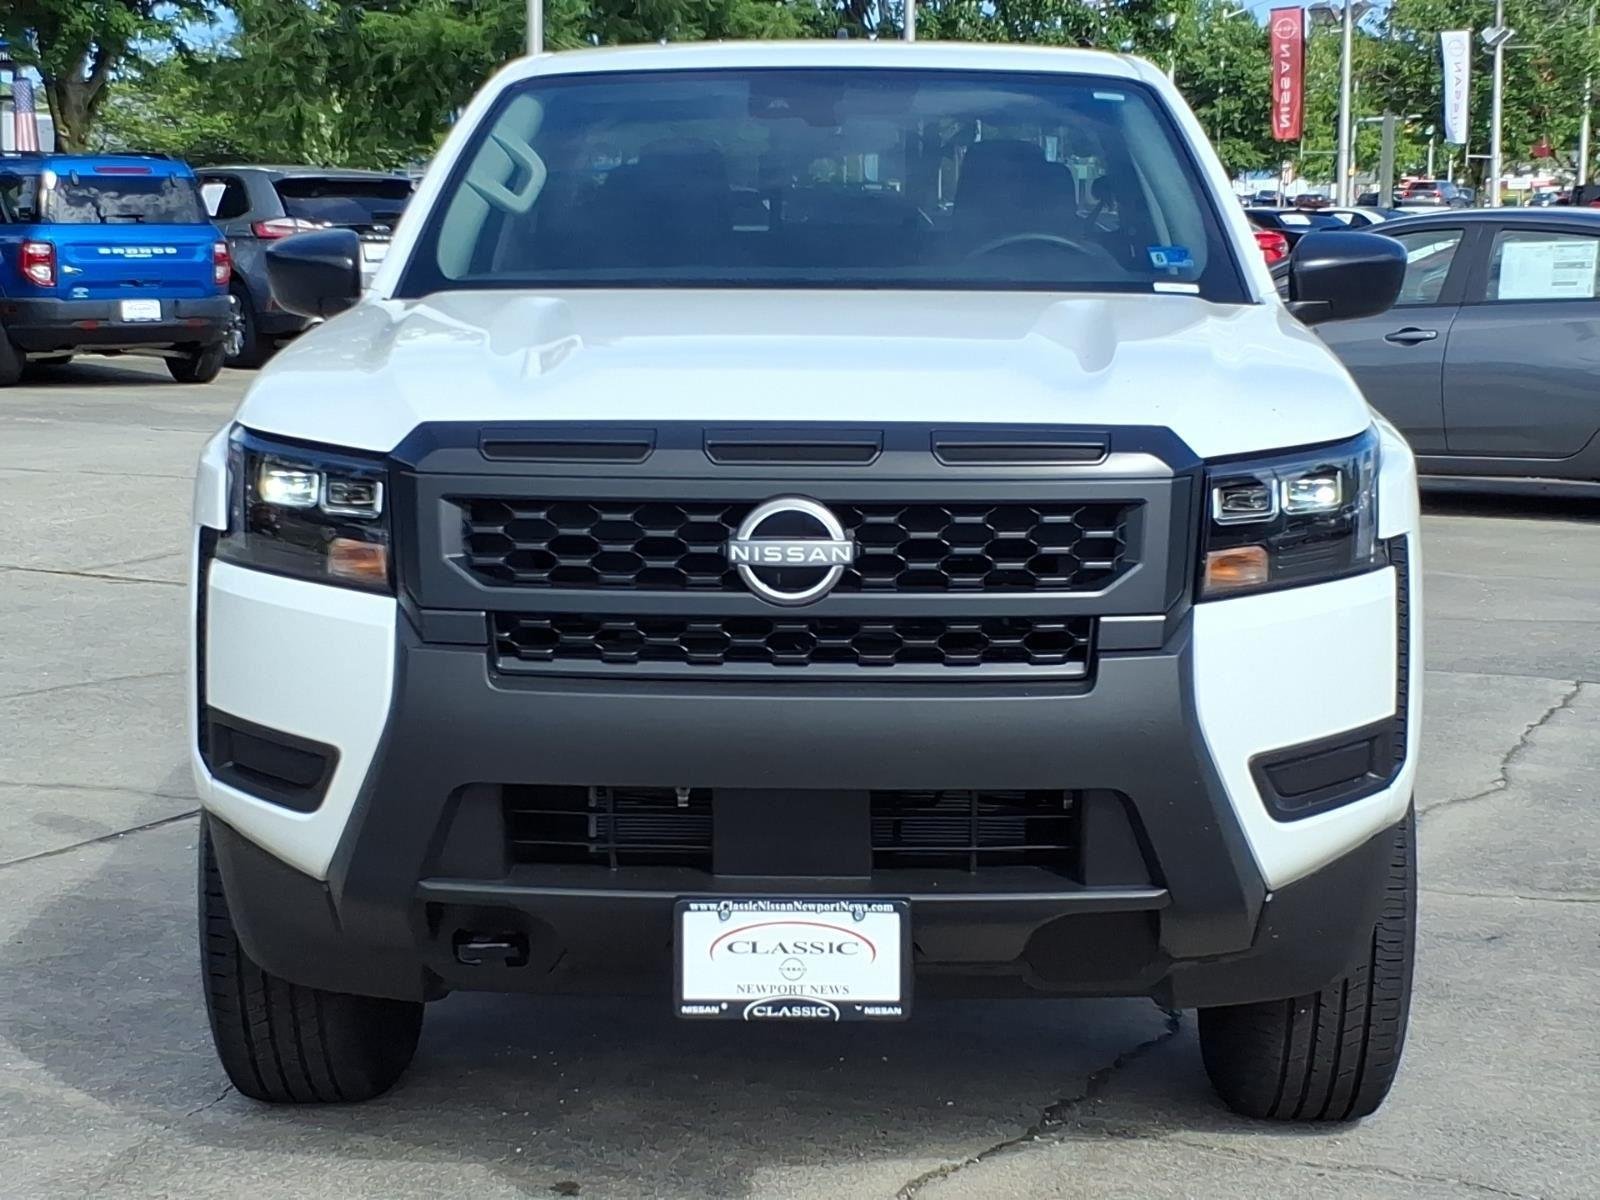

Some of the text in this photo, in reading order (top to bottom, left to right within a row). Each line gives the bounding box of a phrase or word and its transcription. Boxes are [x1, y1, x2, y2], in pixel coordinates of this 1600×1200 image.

[731, 546, 851, 562] NISSAN
[689, 900, 894, 913] www.ClassicNissanNewportNews.com
[727, 941, 859, 955] CLASSIC
[736, 984, 850, 996] NEWPORT NEWS
[681, 1005, 720, 1014] NISSAN
[752, 1006, 831, 1017] CLASSIC
[864, 1007, 902, 1015] NISSAN
